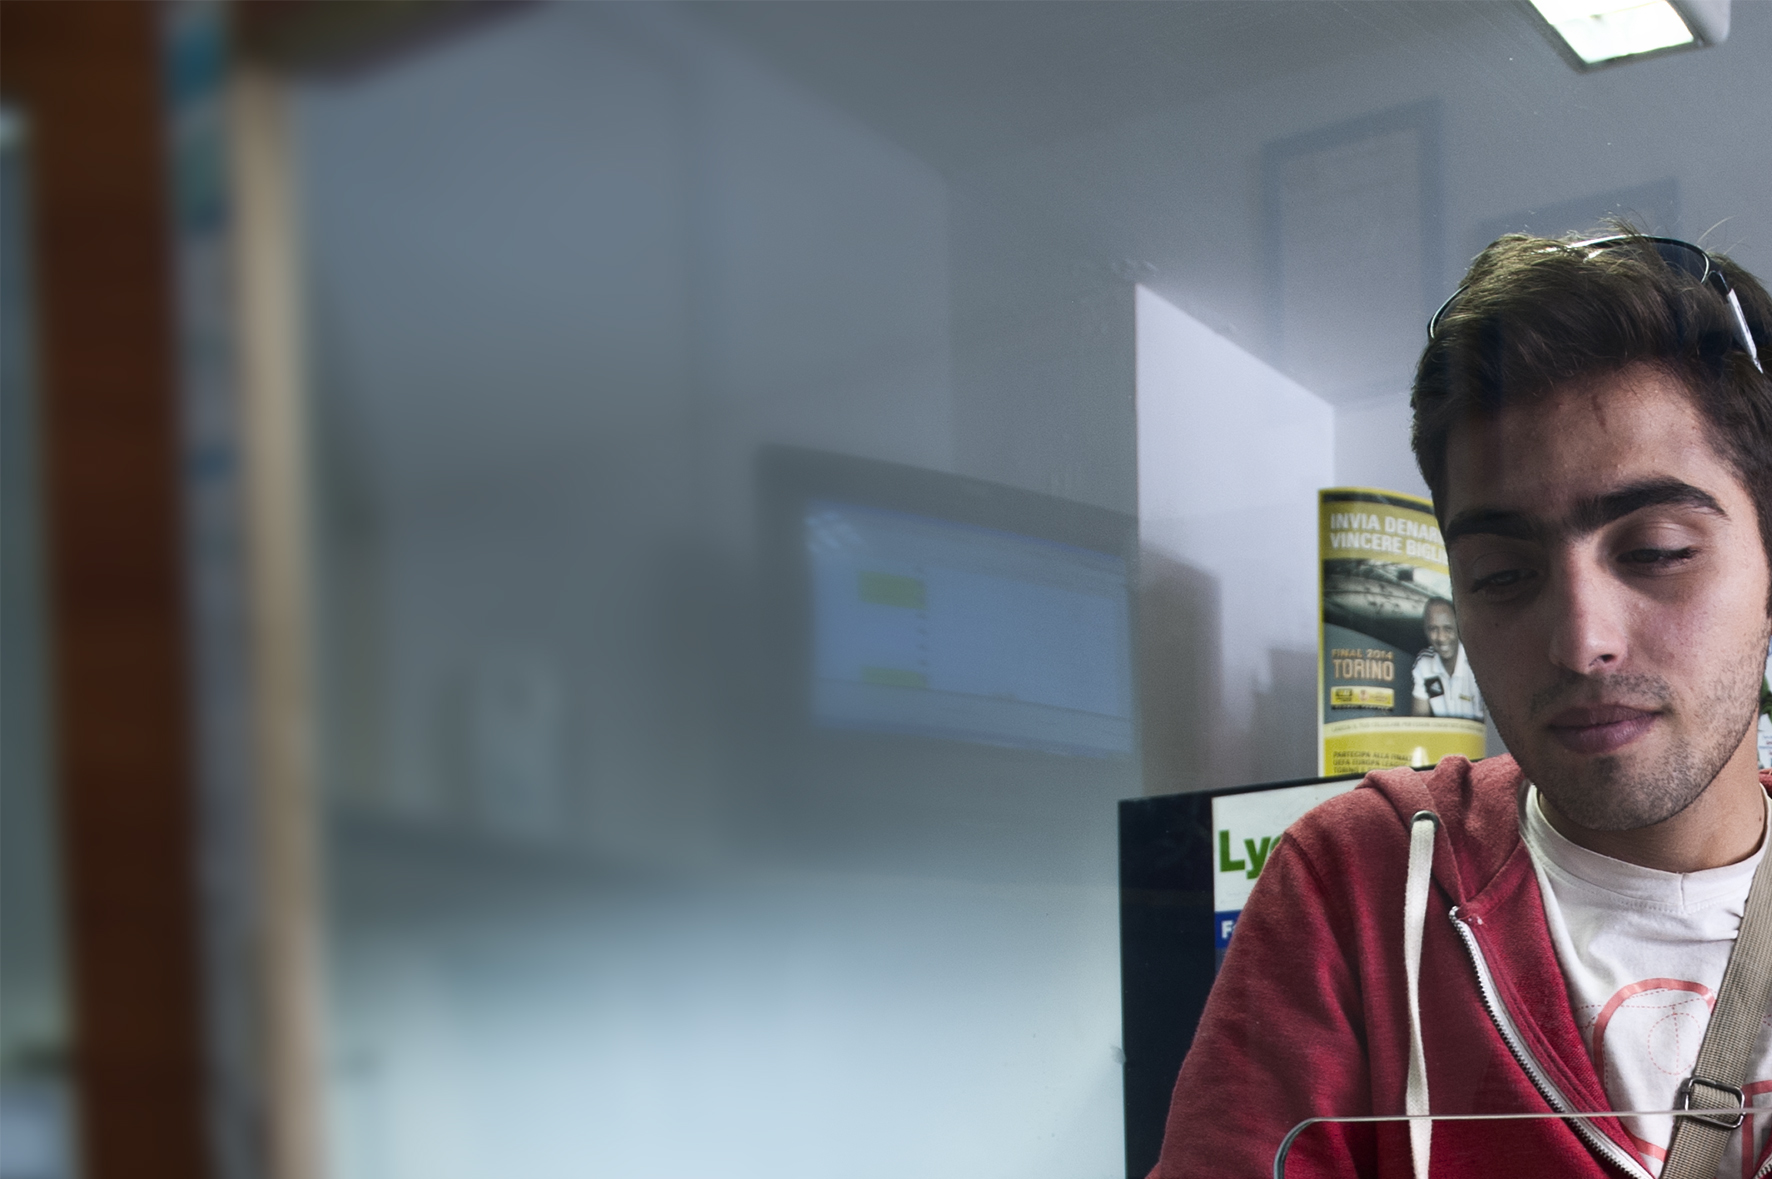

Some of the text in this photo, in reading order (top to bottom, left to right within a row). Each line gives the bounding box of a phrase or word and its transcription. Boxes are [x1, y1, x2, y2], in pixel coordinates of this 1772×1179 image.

[1330, 513, 1381, 531] INVIA
[1330, 531, 1402, 554] VINCERE
[1332, 648, 1394, 661] FINAL 2014
[1332, 658, 1396, 682] TORINO
[1218, 829, 1283, 880] Ly
